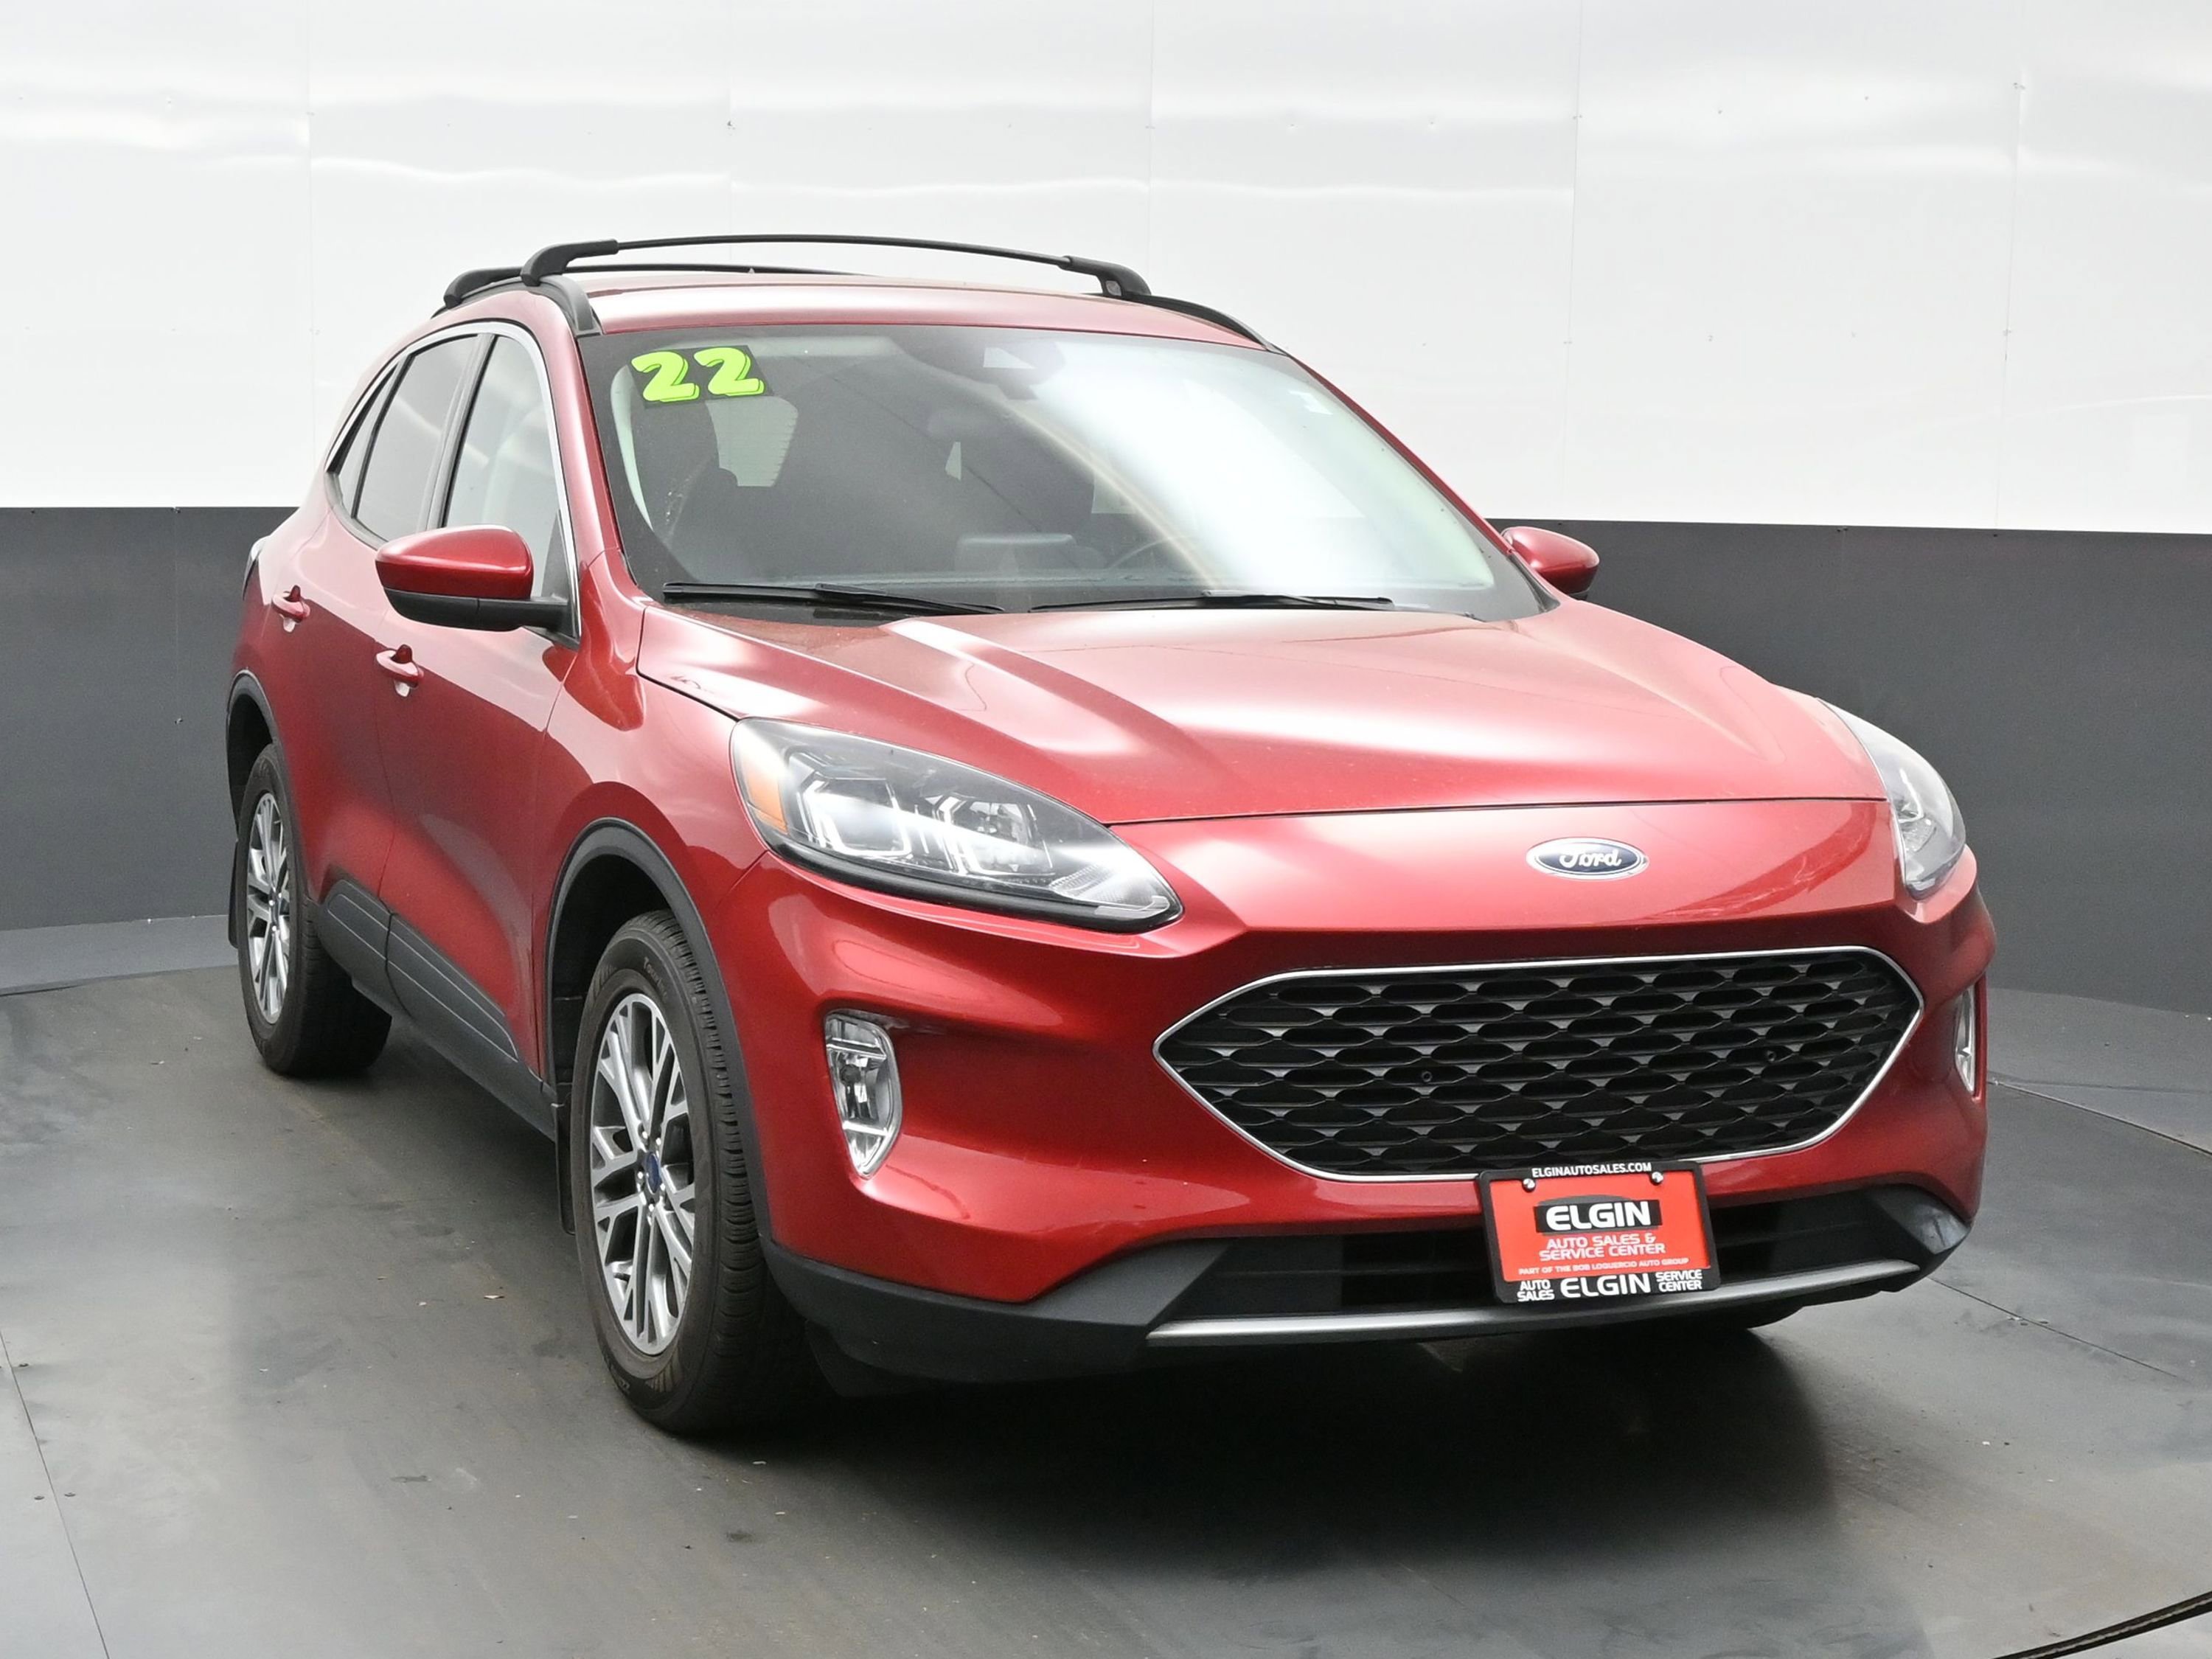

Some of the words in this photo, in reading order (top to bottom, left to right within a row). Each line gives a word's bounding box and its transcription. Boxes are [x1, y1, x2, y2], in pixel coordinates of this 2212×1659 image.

[631, 347, 765, 402] 22
[1559, 849, 1622, 868] Ford
[1531, 1163, 1652, 1178] ELGINAUTOSALES.COM
[1545, 1201, 1652, 1231] ELGIN
[1546, 1236, 1587, 1249] AUTO
[1593, 1234, 1640, 1247] SALES
[1645, 1232, 1656, 1243] &
[1539, 1248, 1604, 1262] SERVICE
[1609, 1243, 1666, 1256] CENTER
[1554, 1265, 1571, 1273] THE
[1638, 1259, 1660, 1267] AUTO
[1661, 1257, 1689, 1266] GROUP
[1655, 1269, 1703, 1282] SERVICE
[1520, 1279, 1551, 1292] AUTO
[1559, 1273, 1652, 1298] ELGIN
[1658, 1279, 1703, 1293] CENTER
[1517, 1289, 1554, 1302] SALES
